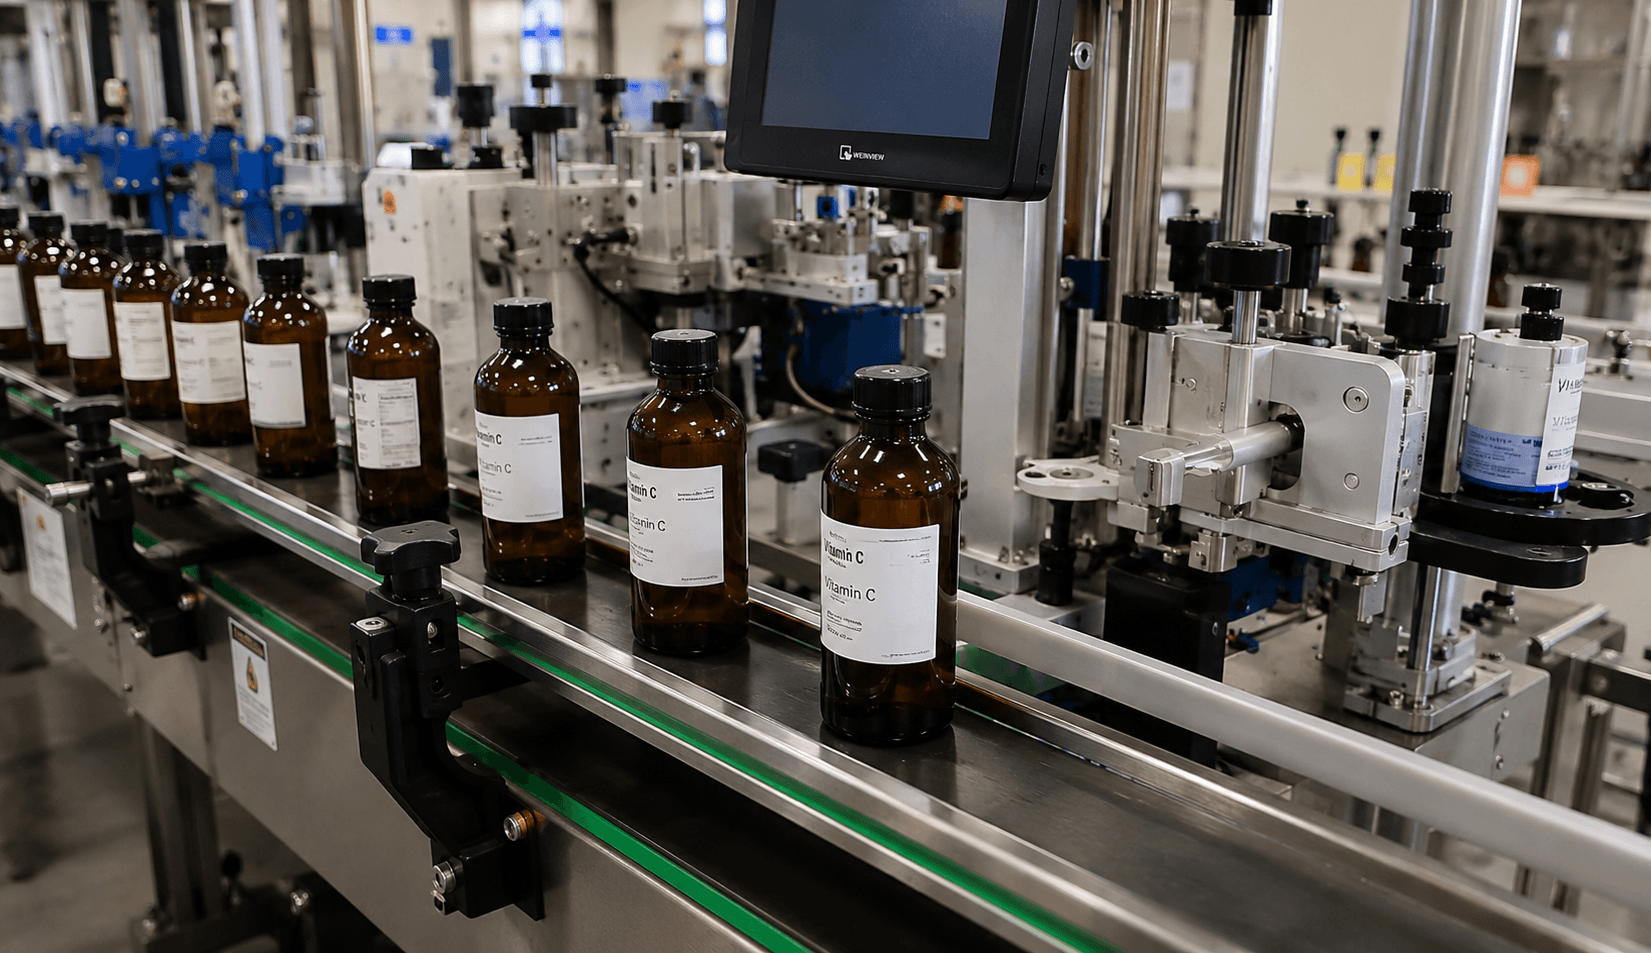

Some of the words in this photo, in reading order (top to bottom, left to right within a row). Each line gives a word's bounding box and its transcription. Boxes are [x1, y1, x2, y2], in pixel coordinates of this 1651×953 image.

[496, 433, 502, 445] C
[504, 463, 512, 474] C
[649, 486, 657, 499] C
[657, 520, 666, 532] C
[855, 550, 864, 564] C
[824, 575, 862, 600] Vitamin
[865, 588, 876, 602] C
